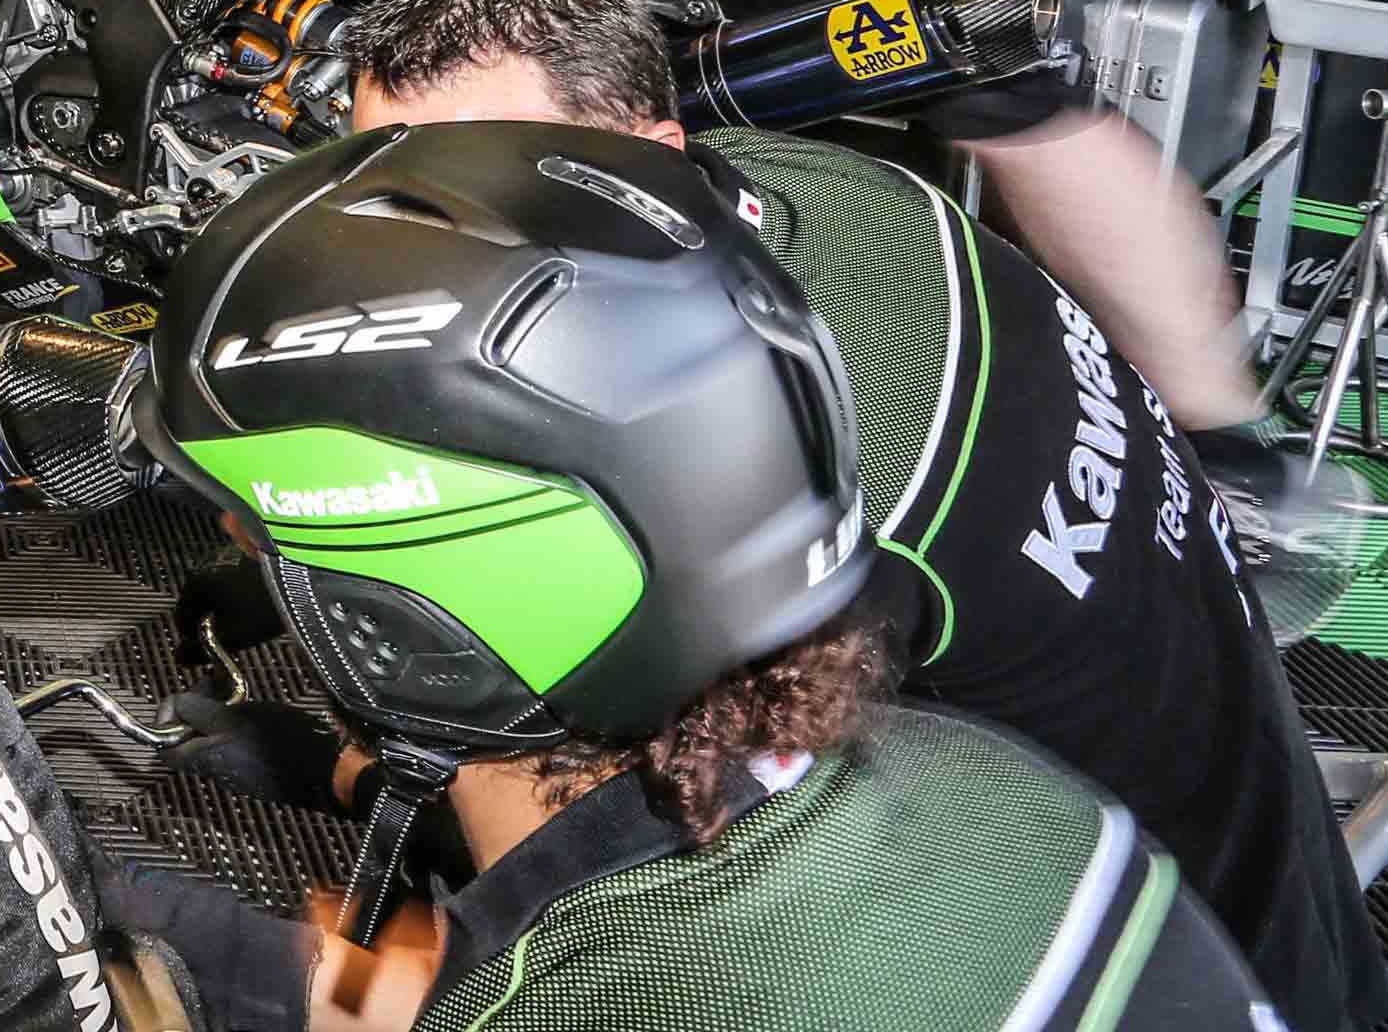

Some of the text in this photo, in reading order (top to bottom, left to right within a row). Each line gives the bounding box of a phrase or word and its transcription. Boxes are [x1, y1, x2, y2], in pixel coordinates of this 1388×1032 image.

[850, 40, 925, 78] ARROW
[1, 277, 64, 302] FRANCE
[214, 301, 463, 371] LS2
[250, 469, 442, 519] Kawasaki
